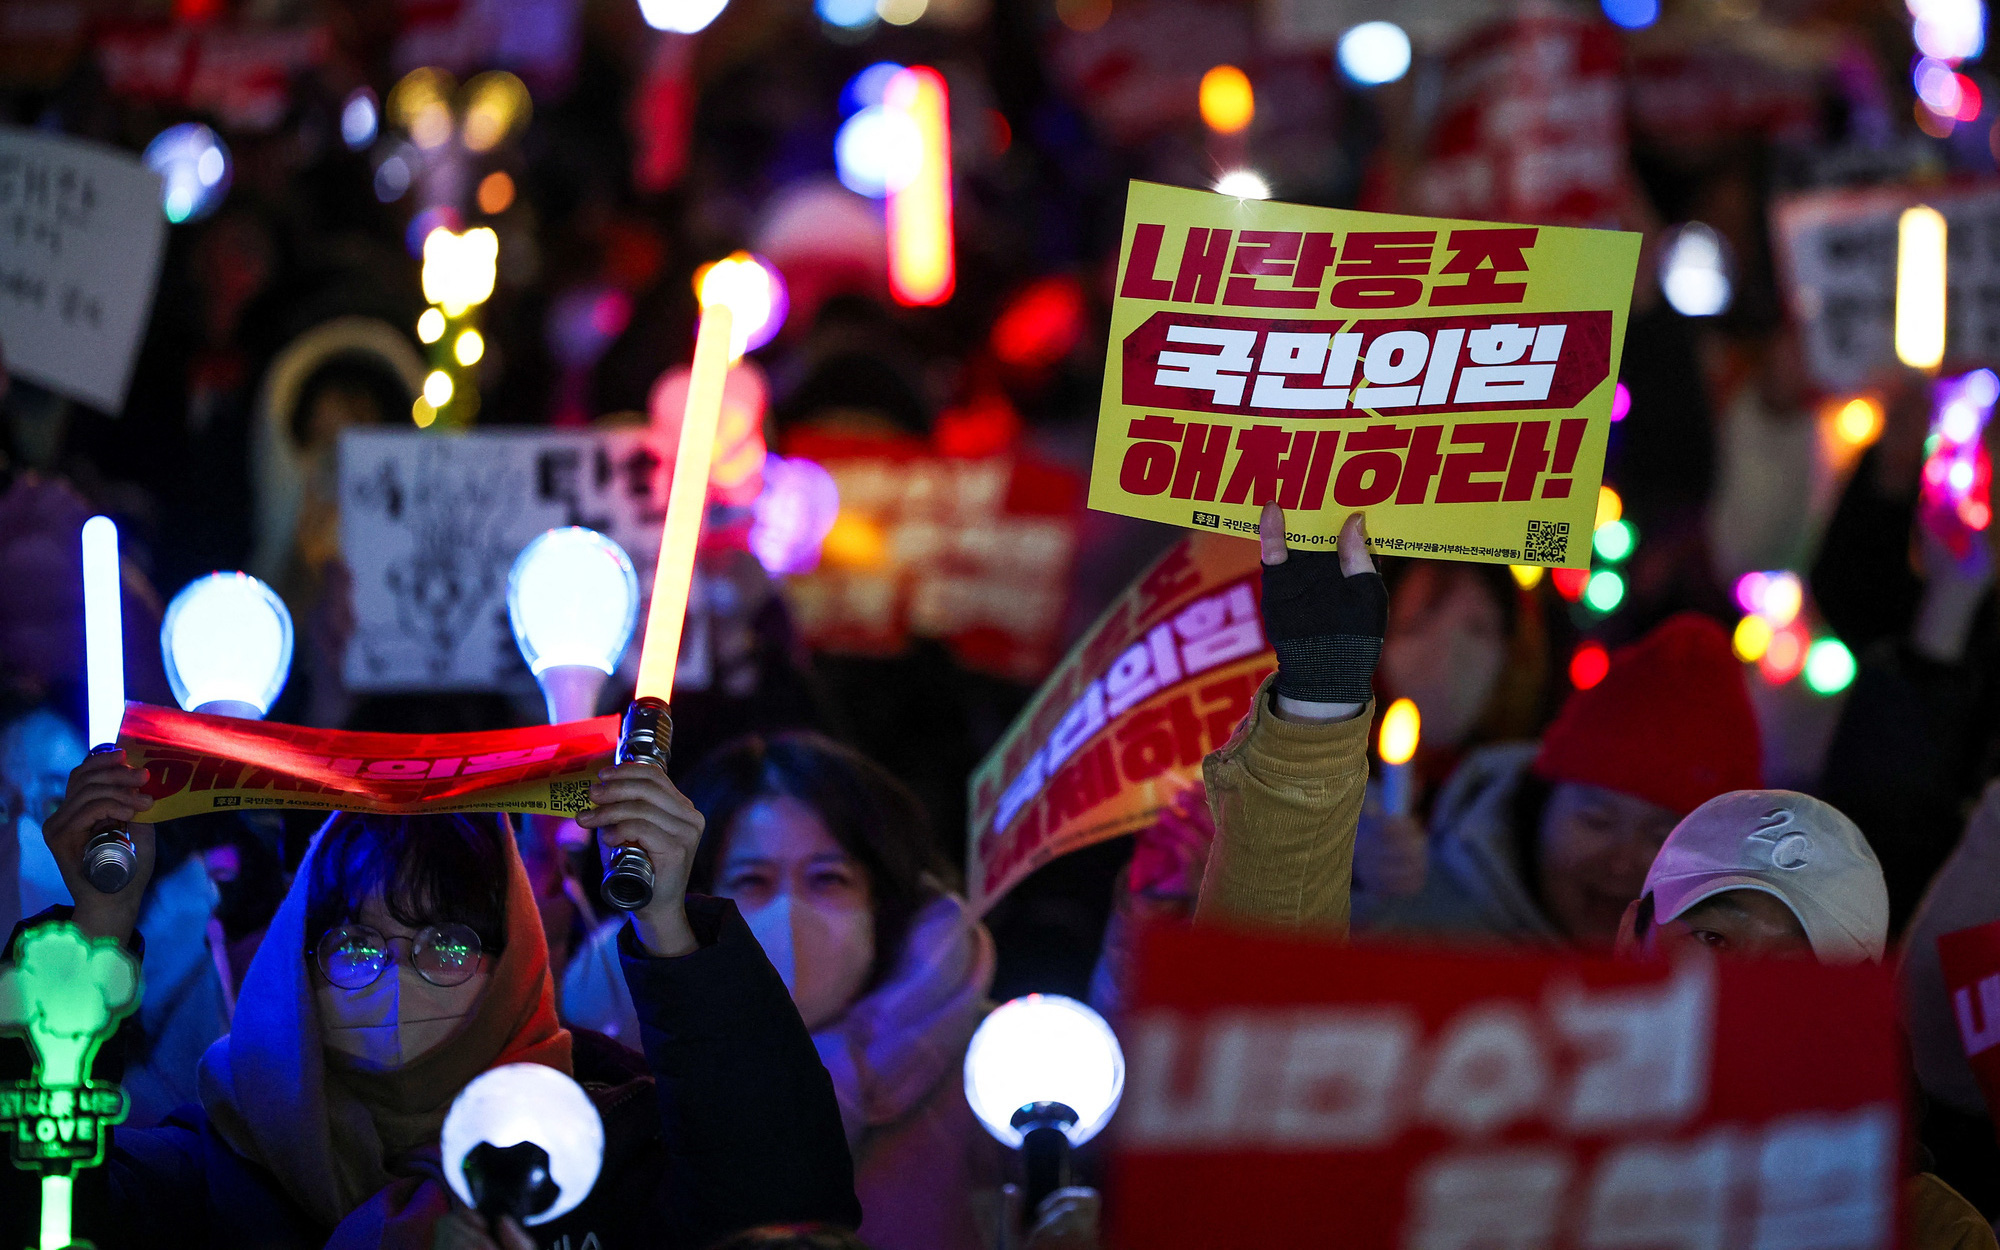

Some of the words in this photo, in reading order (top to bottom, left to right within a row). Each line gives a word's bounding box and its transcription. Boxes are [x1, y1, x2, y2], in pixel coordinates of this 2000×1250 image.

[1121, 223, 1539, 309] 내란동조
[1154, 323, 1567, 409] 국민의힘
[1119, 415, 1588, 511] 해체하라!
[1194, 512, 1218, 527] 후원
[18, 1117, 95, 1143] LOVE
